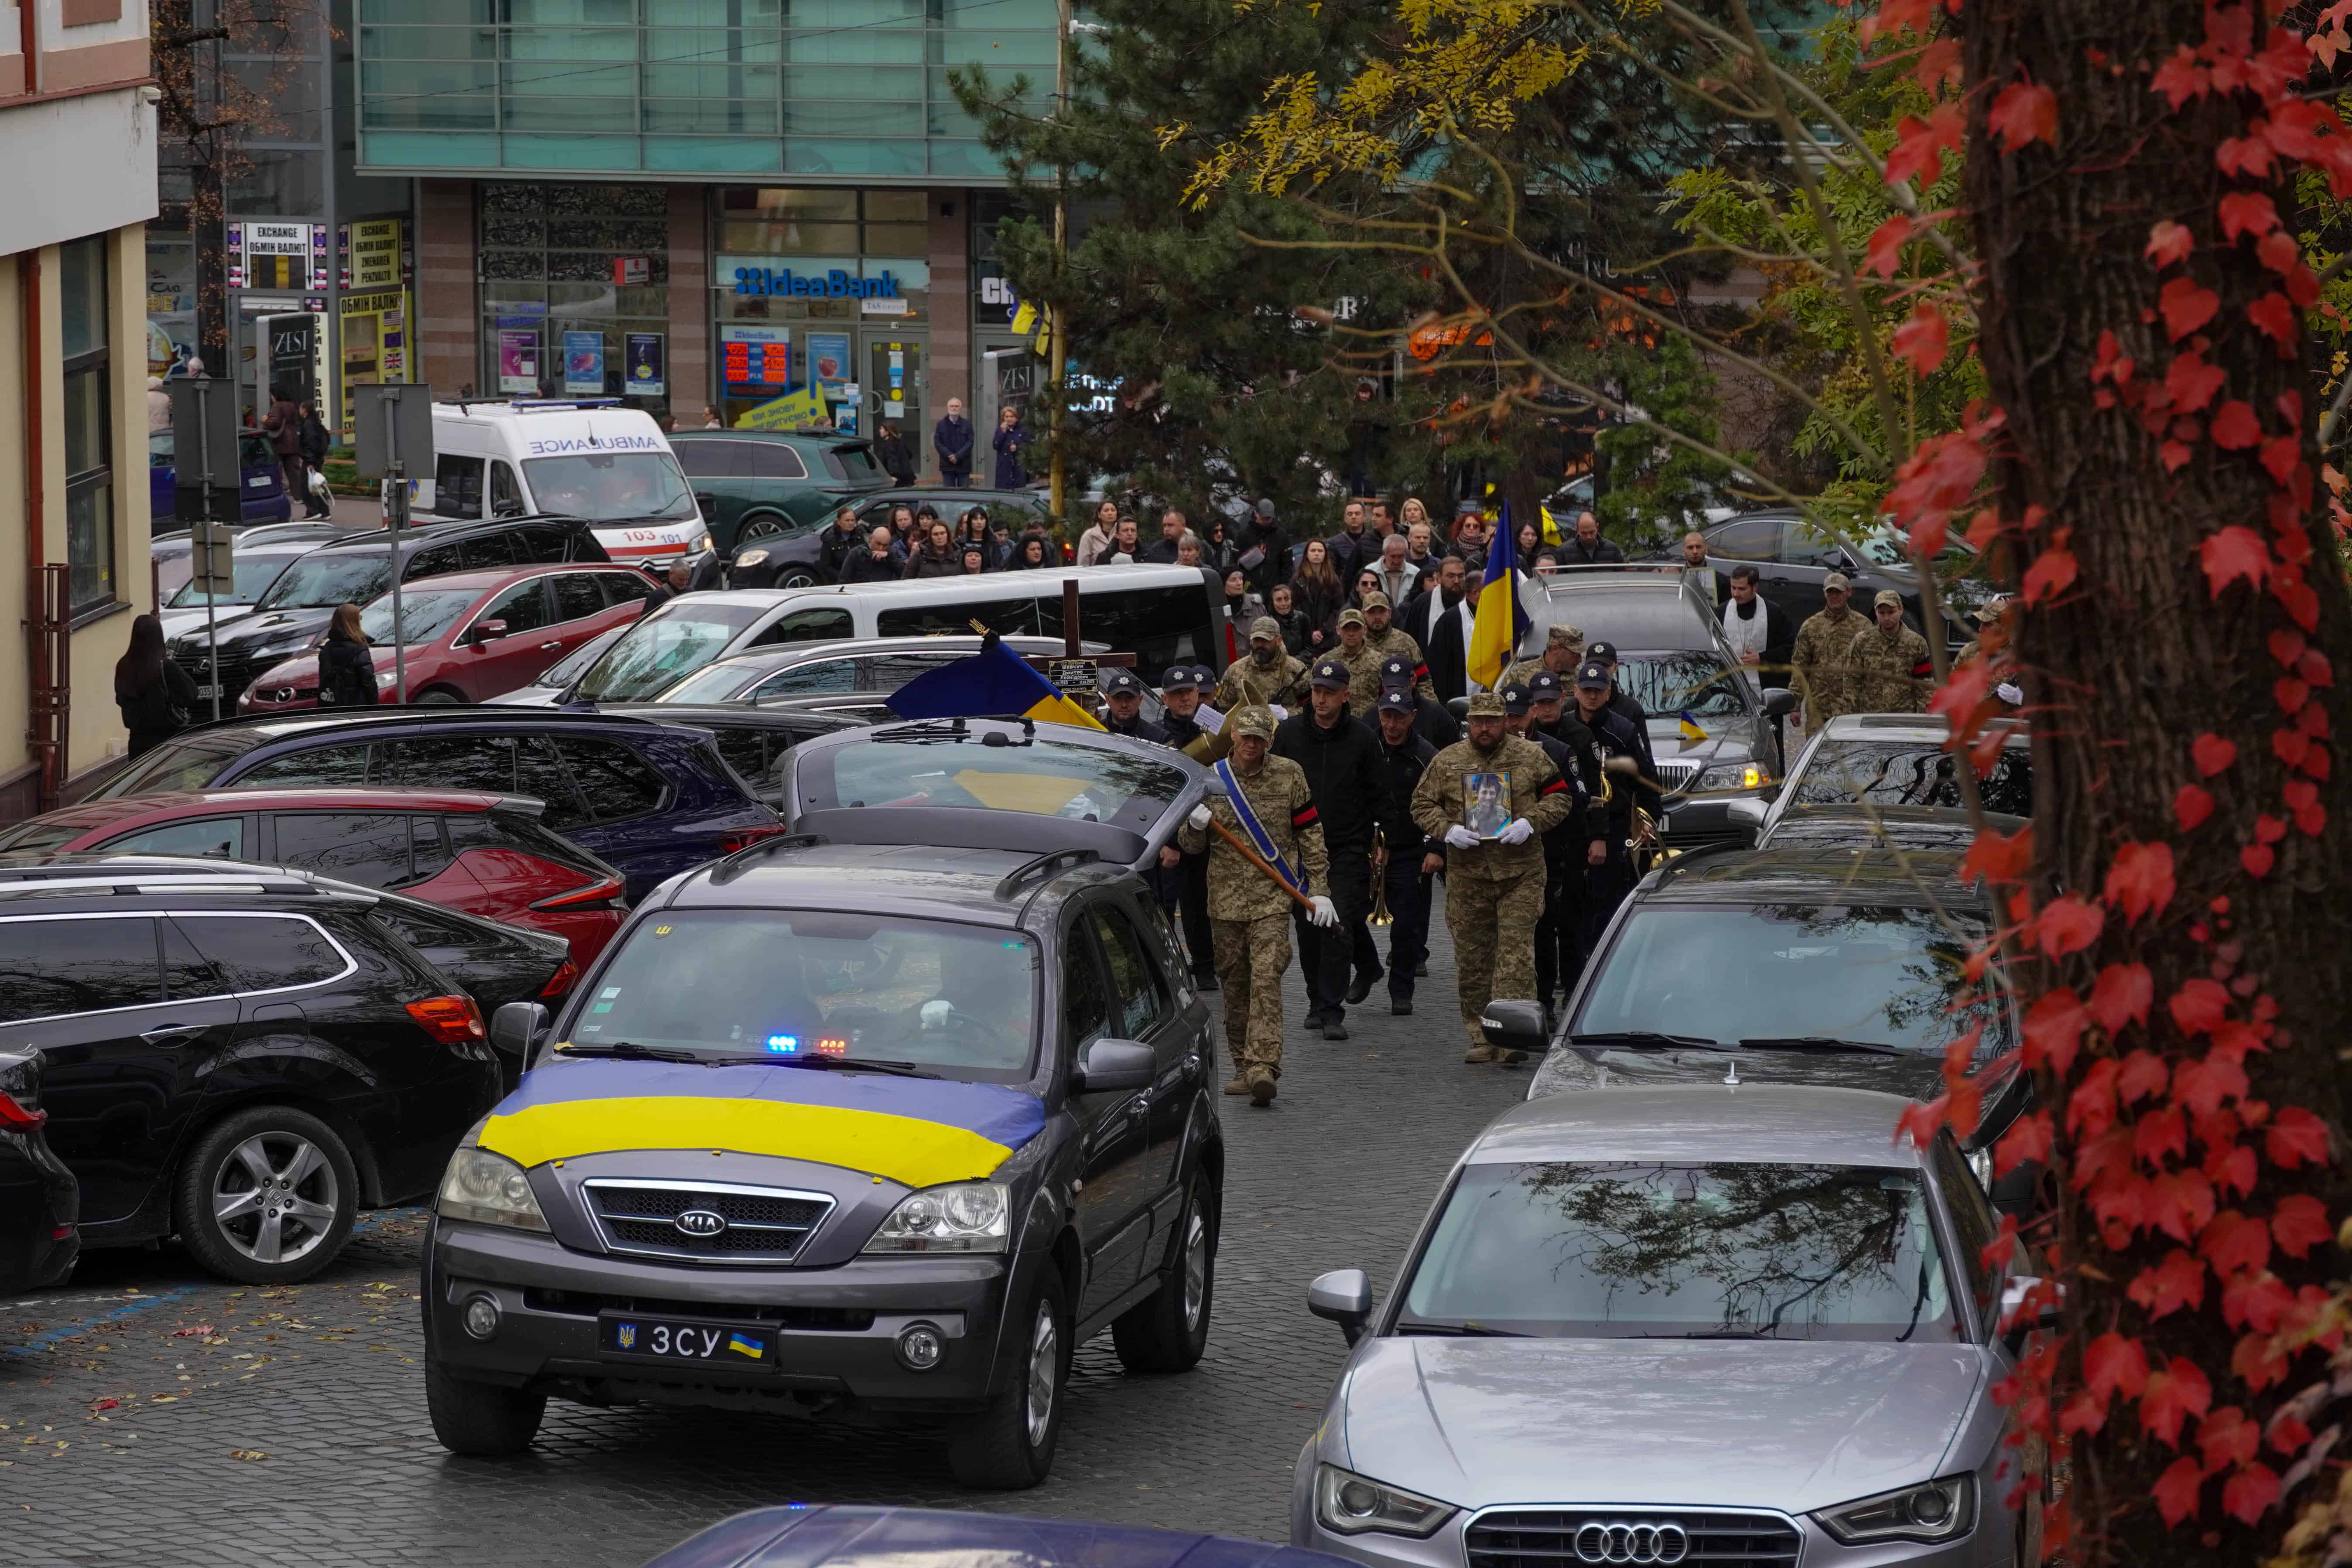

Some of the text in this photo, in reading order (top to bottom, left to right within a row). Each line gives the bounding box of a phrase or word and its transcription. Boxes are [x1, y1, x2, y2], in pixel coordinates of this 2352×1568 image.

[258, 226, 297, 238] EXCHANGE
[361, 224, 390, 237] EXCHANGE
[250, 242, 306, 253] ОБМІН ВАЛЮТ
[356, 239, 396, 253] ОБМІН ВАЛЮТ
[342, 296, 369, 314] ОБМІН
[274, 330, 310, 354] ZEST
[1001, 366, 1030, 391] ZEST
[622, 530, 656, 543] 103
[683, 1216, 716, 1231] KIA
[651, 1325, 721, 1358] ЗСУ
